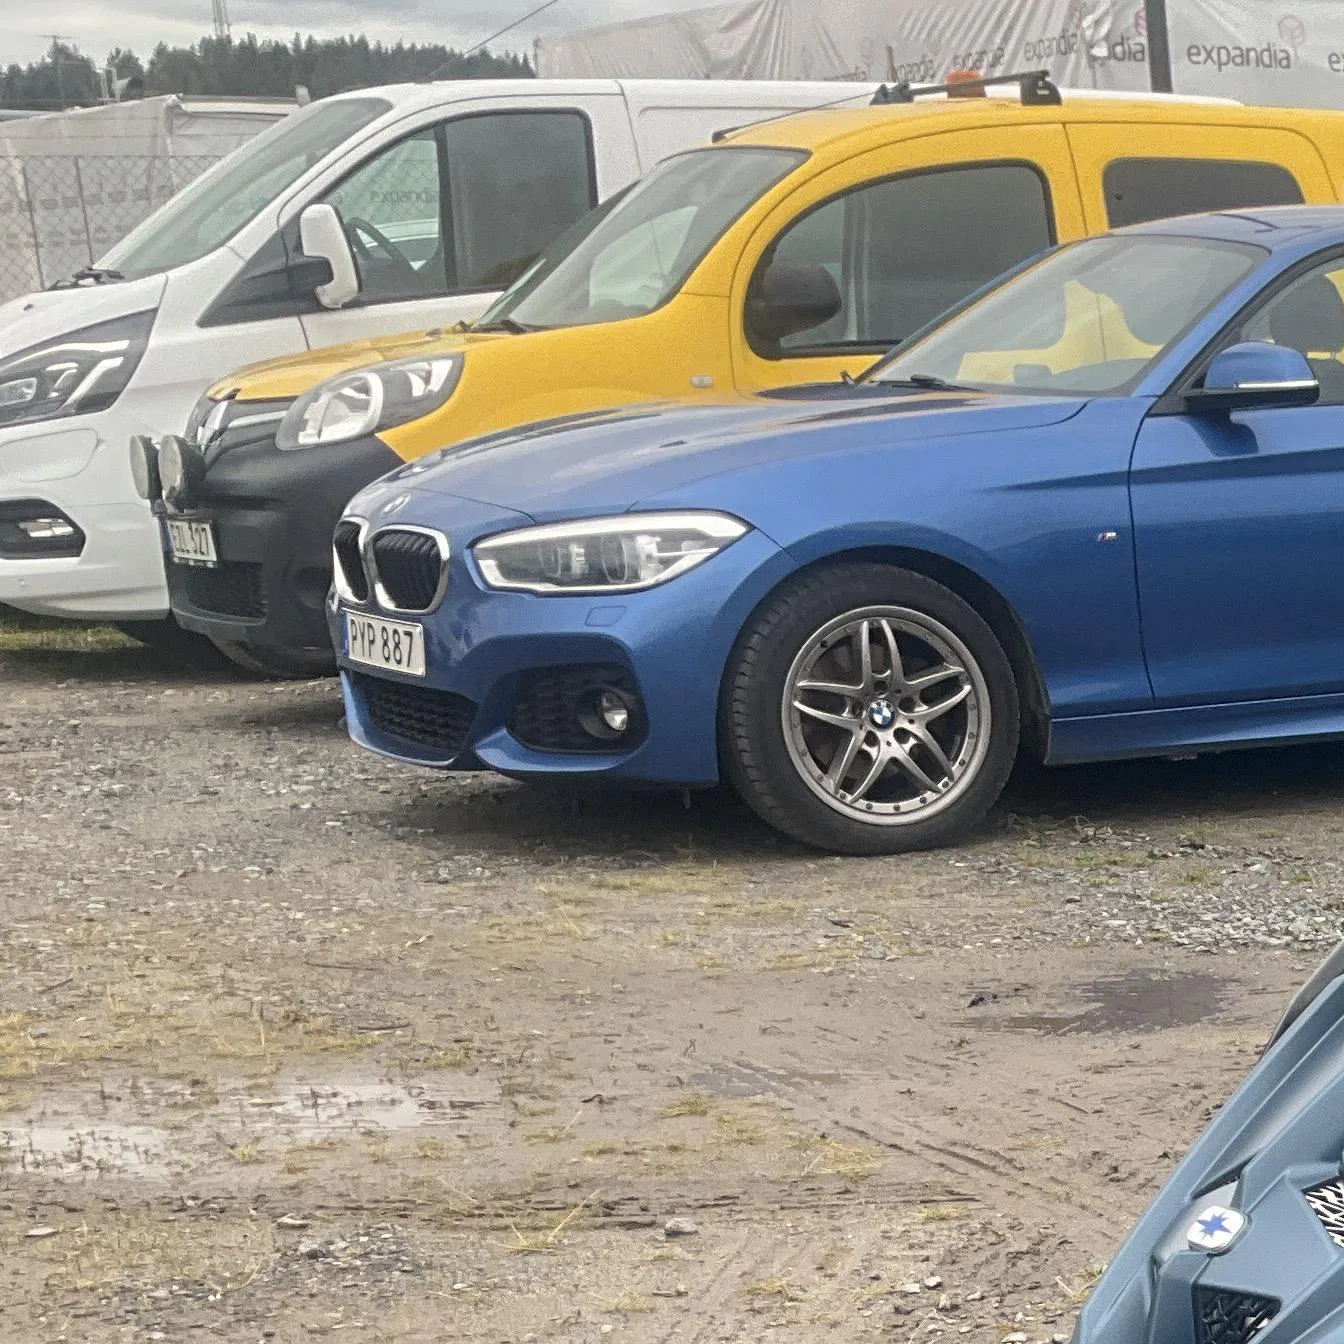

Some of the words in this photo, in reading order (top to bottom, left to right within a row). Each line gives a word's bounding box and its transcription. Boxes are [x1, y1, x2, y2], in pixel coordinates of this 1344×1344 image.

[1186, 42, 1292, 72] expandia
[350, 618, 376, 659] PYP
[381, 625, 413, 668] 887
